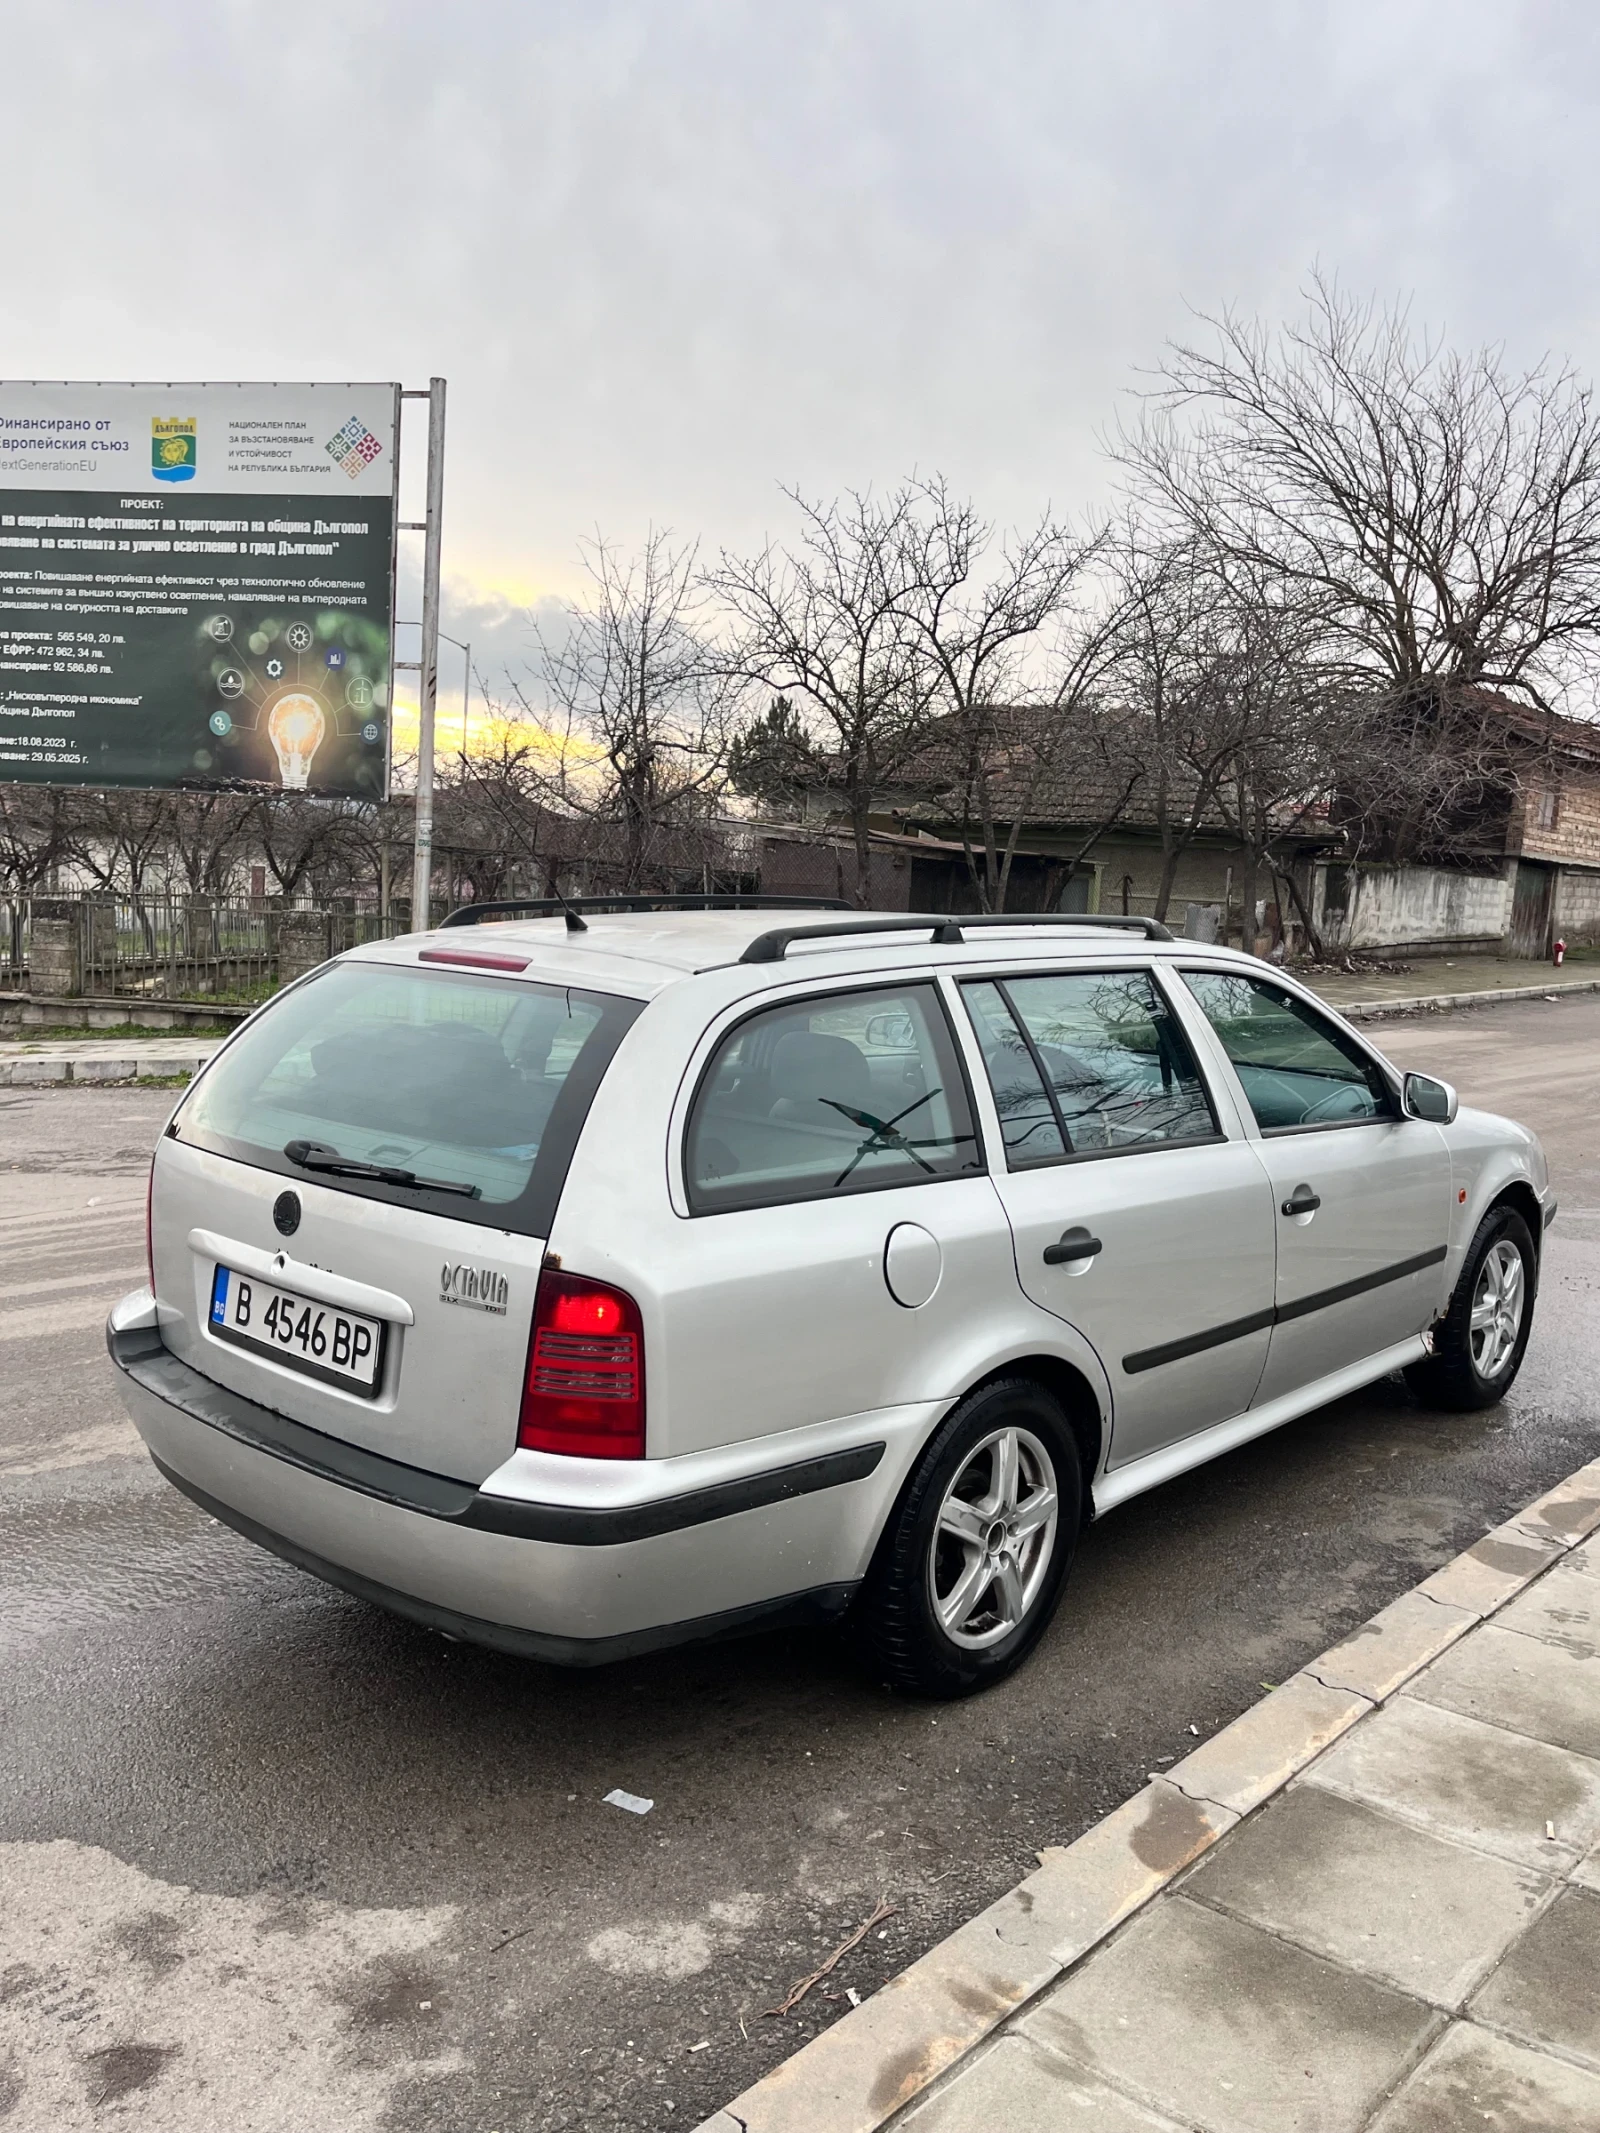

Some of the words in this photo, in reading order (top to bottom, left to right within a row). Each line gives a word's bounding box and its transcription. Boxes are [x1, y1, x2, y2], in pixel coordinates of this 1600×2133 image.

[95, 420, 111, 431] от
[229, 421, 283, 429] НАЦИОНАЛЕН
[0, 436, 87, 452] вропейския
[91, 441, 129, 451] съюз
[241, 436, 314, 444] ВЪЗСТАНОВЯВАНЕ
[235, 449, 292, 458] УСТОЙЧИВОСТ
[0, 458, 97, 472] extGenerationEU
[290, 465, 331, 473] БЪЛГАРИЯ
[120, 499, 164, 510] ПРОЕКТ:
[1, 515, 15, 526] на
[17, 514, 86, 529] енергийната
[88, 516, 160, 531] ефективност
[162, 518, 176, 530] на
[179, 519, 249, 533] територията
[251, 521, 265, 532] на
[267, 519, 311, 534] община
[313, 520, 369, 535] Дългопол
[0, 536, 40, 548] вяване
[41, 538, 55, 549] на
[57, 538, 116, 551] системата
[118, 540, 130, 551] за
[132, 541, 171, 553] улично
[173, 541, 237, 553] осветление
[240, 543, 248, 554] в
[250, 543, 276, 556] град
[34, 570, 93, 582] Повишаване
[95, 573, 153, 585] енергийната
[155, 574, 214, 586] ефективност
[216, 577, 239, 588] чрез
[241, 578, 306, 587] технологично
[307, 577, 366, 589] обновление
[2, 586, 14, 594] на
[15, 587, 64, 596] системите
[65, 588, 77, 597] за
[78, 589, 114, 597] външно
[116, 590, 168, 601] изкуствено
[169, 592, 226, 602] осветление,
[228, 593, 286, 602] намаляване
[287, 594, 300, 603] на
[302, 595, 367, 606] въглеродната
[51, 603, 63, 611] на
[64, 603, 120, 614] сигурността
[122, 605, 134, 613] на
[135, 606, 188, 615] доставките
[11, 631, 53, 641] проекта:
[57, 632, 75, 642] 565
[98, 634, 111, 643] 20
[112, 635, 126, 644] лв.
[3, 643, 35, 656] ЕФРР:
[36, 646, 54, 656] 472
[77, 648, 89, 657] 34
[91, 650, 105, 658] лв.
[53, 662, 65, 672] 92
[99, 665, 114, 674] лв.
[31, 706, 76, 718] Дългопол
[31, 752, 81, 764] 29.05.2025
[214, 1300, 225, 1316] BG
[263, 1295, 327, 1357] 4546
